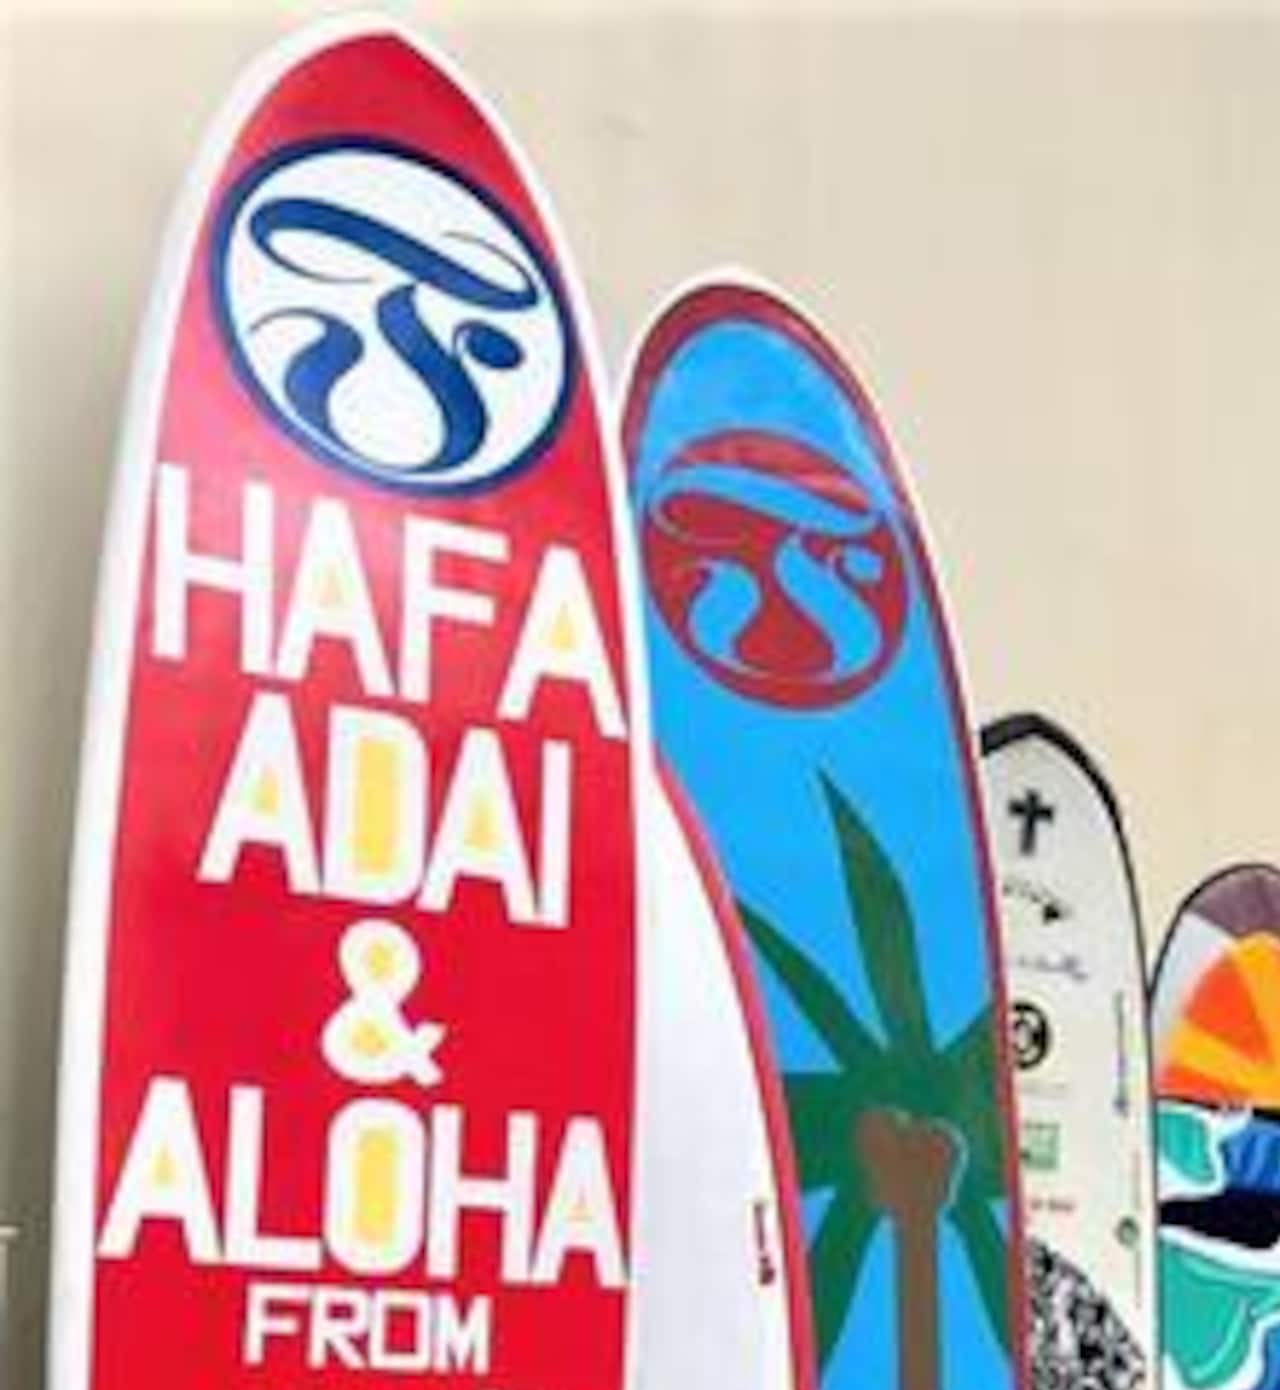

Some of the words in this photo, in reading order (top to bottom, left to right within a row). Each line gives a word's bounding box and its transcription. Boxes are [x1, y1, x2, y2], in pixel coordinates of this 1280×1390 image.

[150, 466, 627, 739] HAFA
[197, 694, 571, 928] ADAI
[322, 920, 447, 1086] &
[96, 1077, 629, 1290] ALOHA
[244, 1283, 492, 1375] FROM
